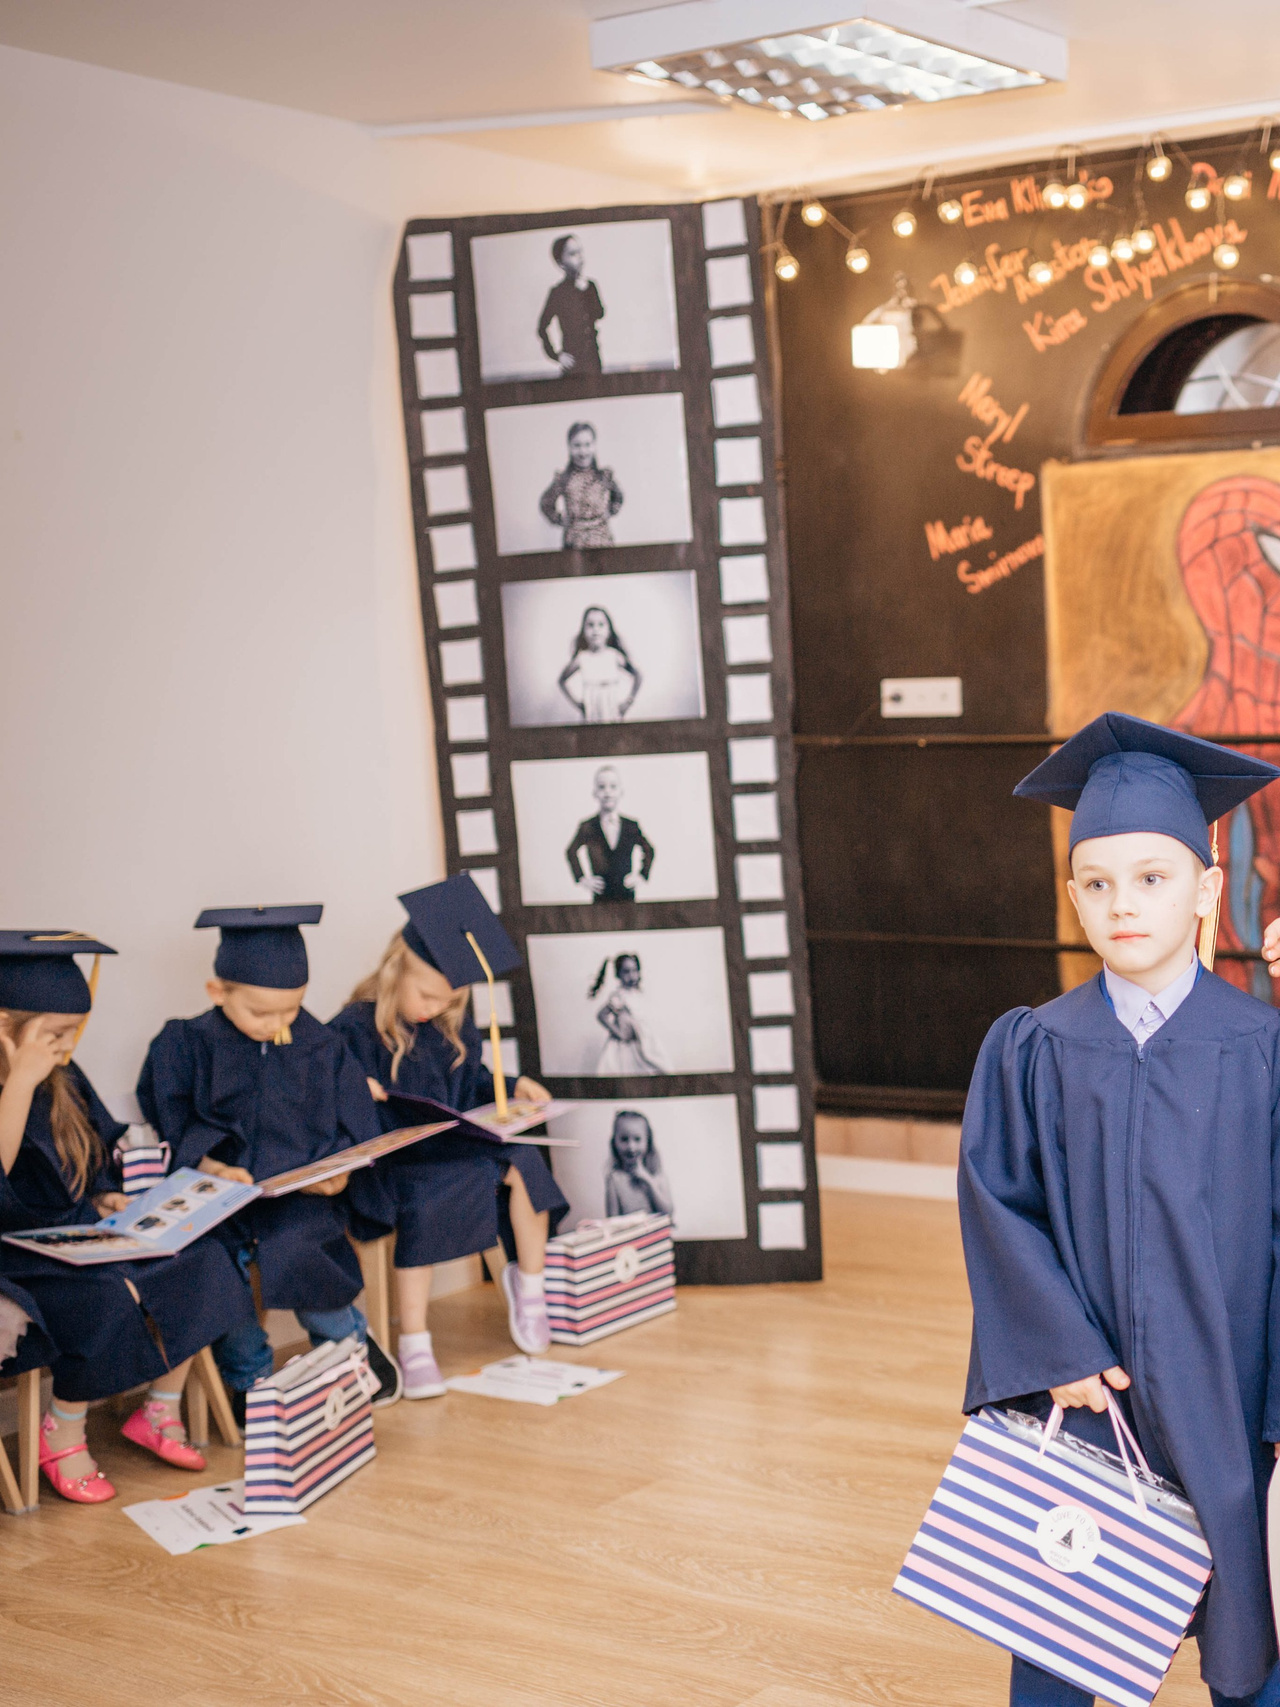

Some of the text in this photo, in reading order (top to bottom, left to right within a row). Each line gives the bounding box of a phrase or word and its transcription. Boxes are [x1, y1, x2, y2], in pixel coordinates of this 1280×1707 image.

[955, 435, 1036, 511] Streep
[924, 514, 994, 561] Maria
[1051, 1511, 1071, 1523] LOVE
